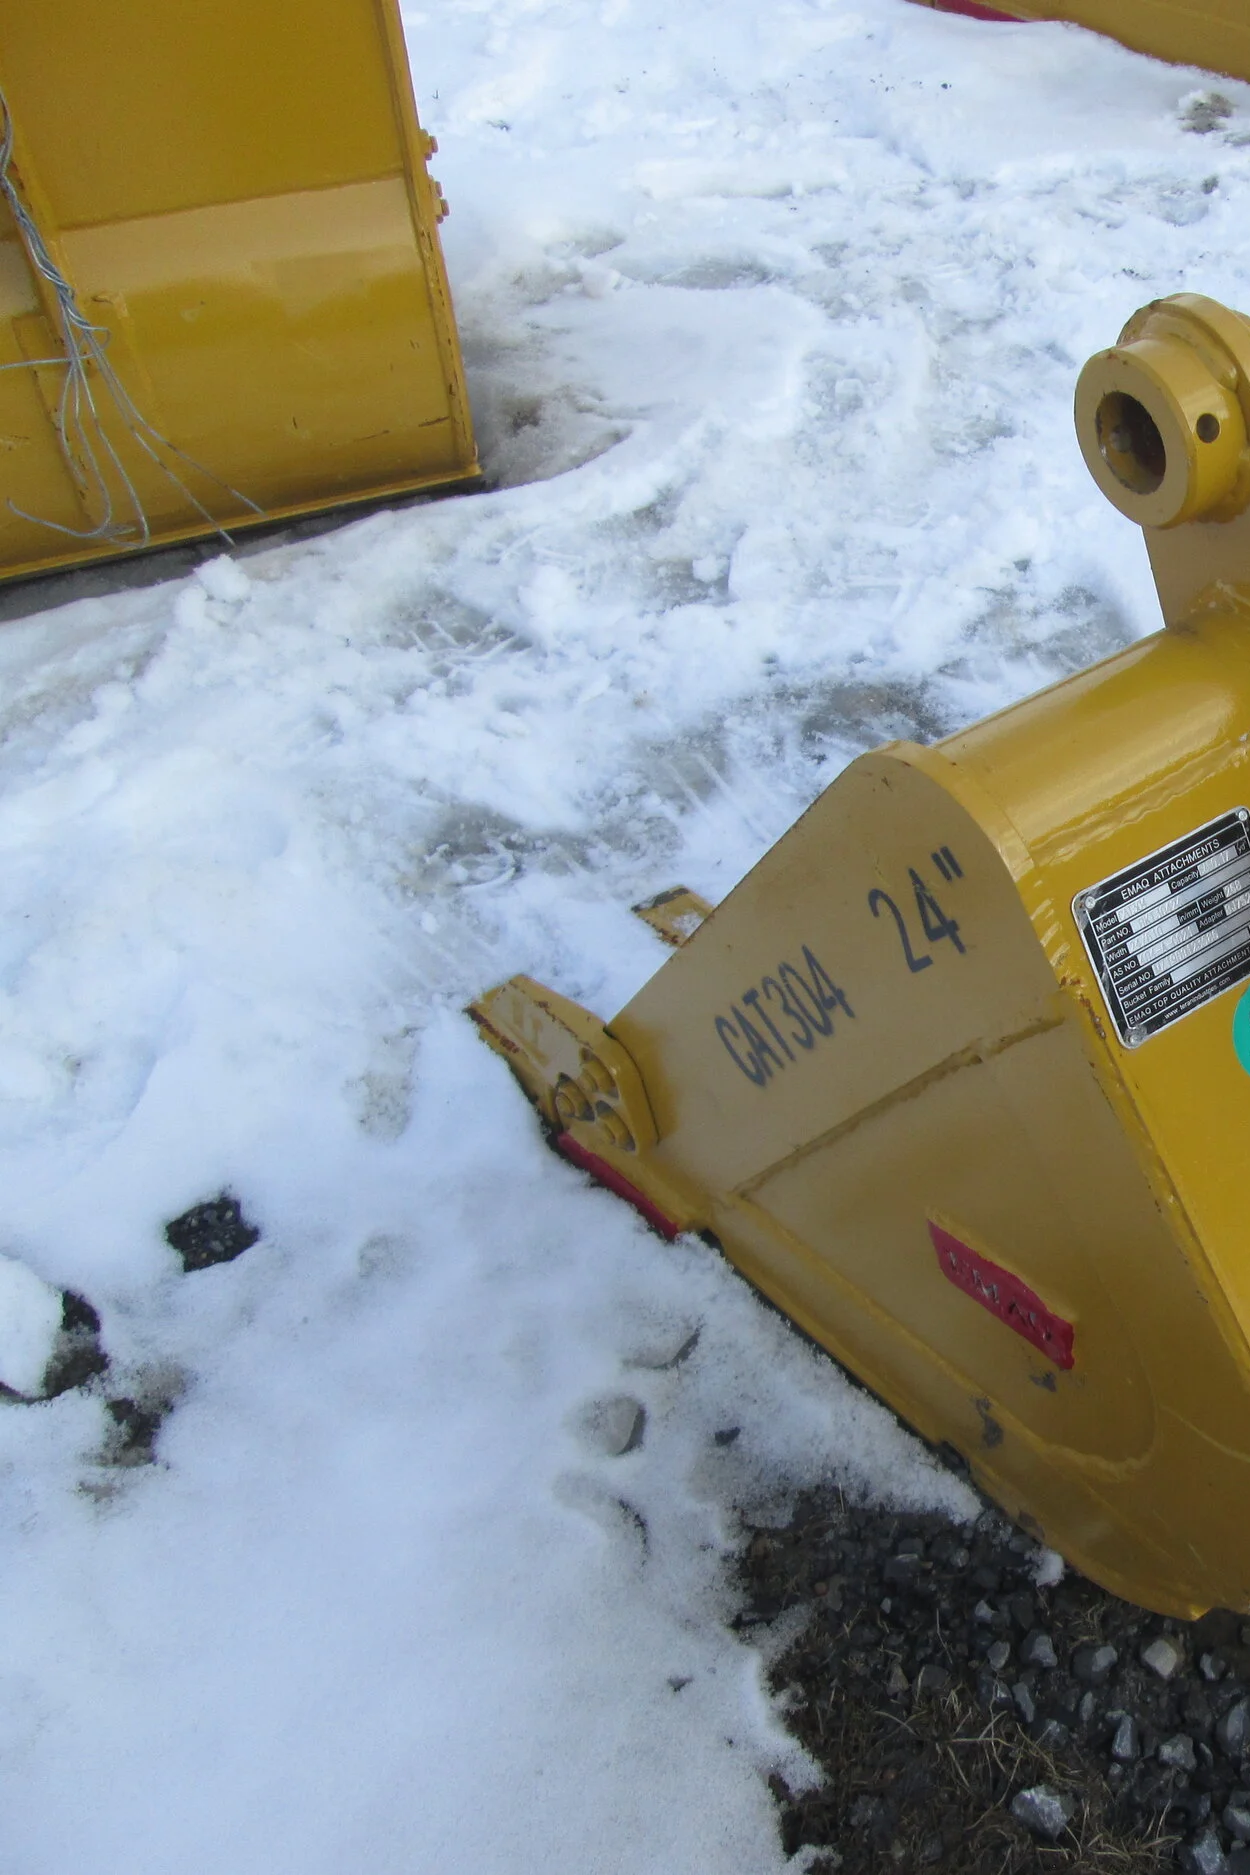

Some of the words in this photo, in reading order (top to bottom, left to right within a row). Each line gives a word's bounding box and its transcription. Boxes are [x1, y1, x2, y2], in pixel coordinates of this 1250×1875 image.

[1095, 915, 1118, 932] Model
[1170, 868, 1201, 891] Capacity
[1120, 877, 1151, 900] EMAQ
[1152, 838, 1221, 883] ATTACHMENTS
[1101, 933, 1118, 947] Part
[1117, 925, 1131, 938] NO.
[1106, 945, 1128, 963] Width
[1200, 889, 1225, 909] Weight
[1112, 967, 1125, 979] AS
[1124, 959, 1139, 972] NO.
[1198, 908, 1225, 929] Adapter
[1118, 977, 1140, 995] Serial
[1139, 969, 1153, 982] NO.
[1123, 990, 1148, 1009] Bucket
[1148, 975, 1172, 996] Family
[1129, 1007, 1152, 1024] EMAQ
[1152, 995, 1170, 1010] TOP
[1170, 975, 1203, 1000] QUALITY
[714, 944, 856, 1087] CAT304
